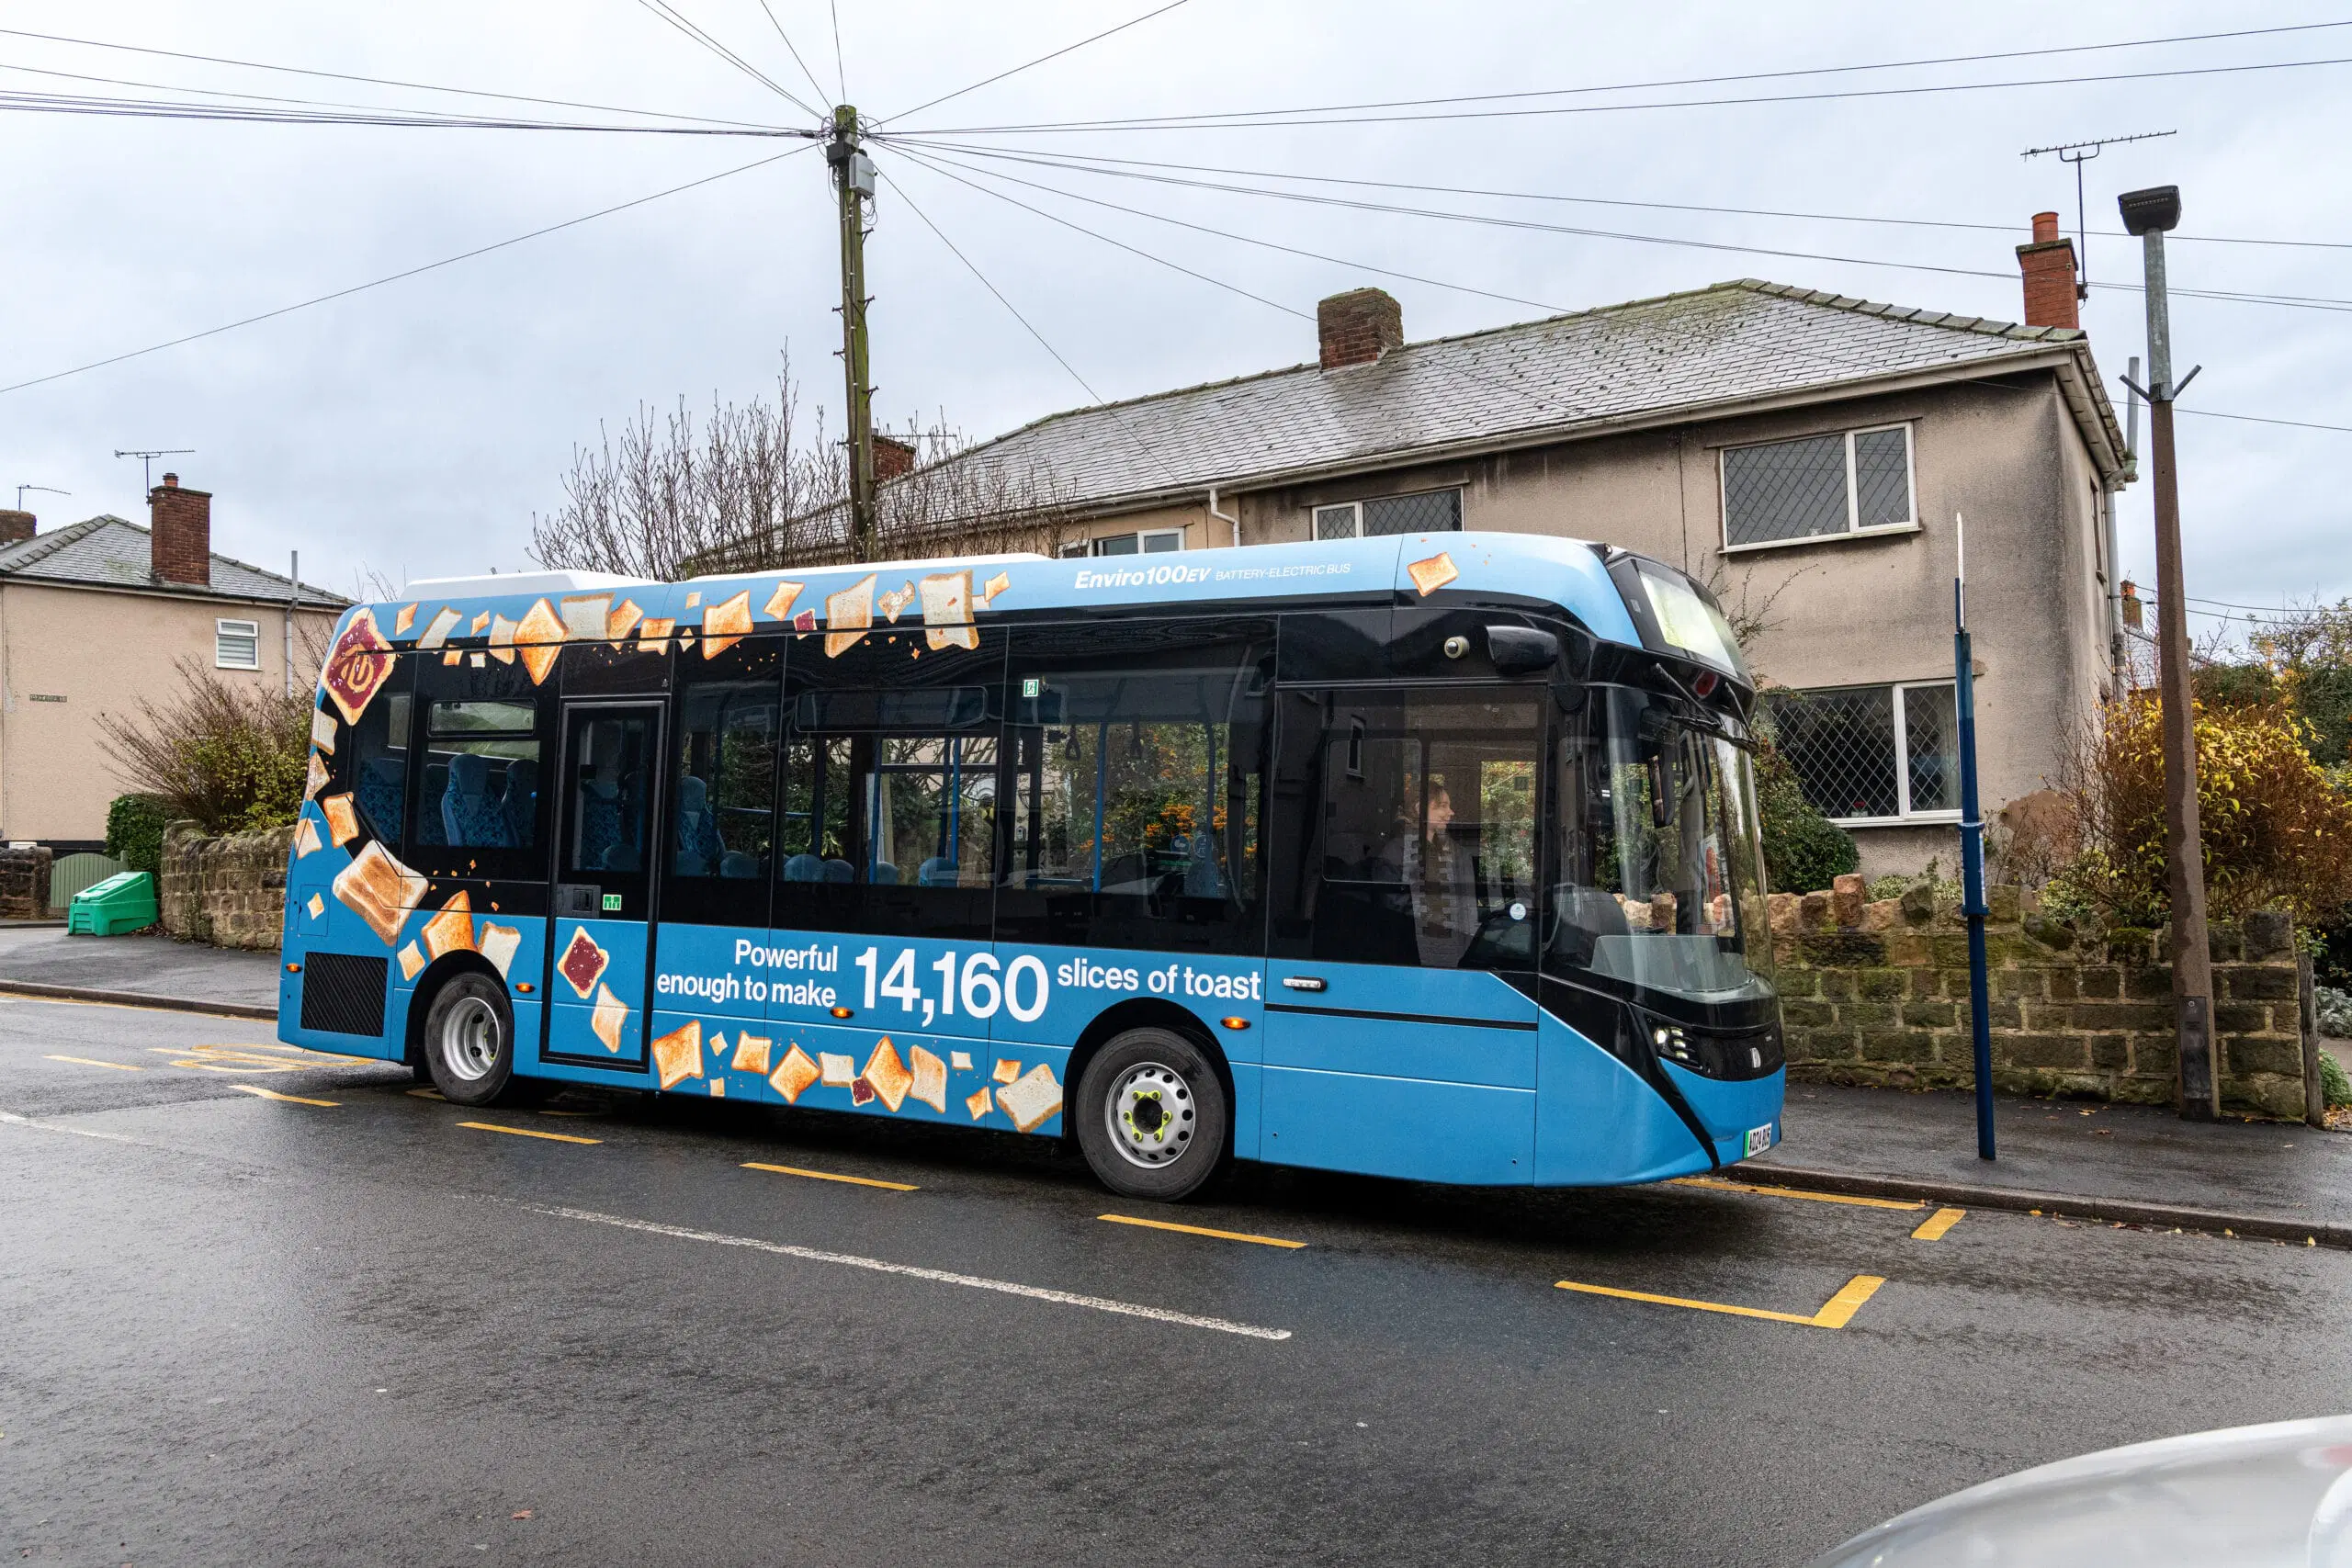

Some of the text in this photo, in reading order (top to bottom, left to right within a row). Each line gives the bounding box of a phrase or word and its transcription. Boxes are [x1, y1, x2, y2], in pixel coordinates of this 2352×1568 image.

[1074, 562, 1351, 589] Enviro100EV BATTERY-ELECTRIC BUS
[736, 939, 839, 972] Powerful
[657, 973, 836, 1008] enough to make
[854, 946, 1049, 1027] 14,160
[1057, 958, 1261, 1000] slices of toast
